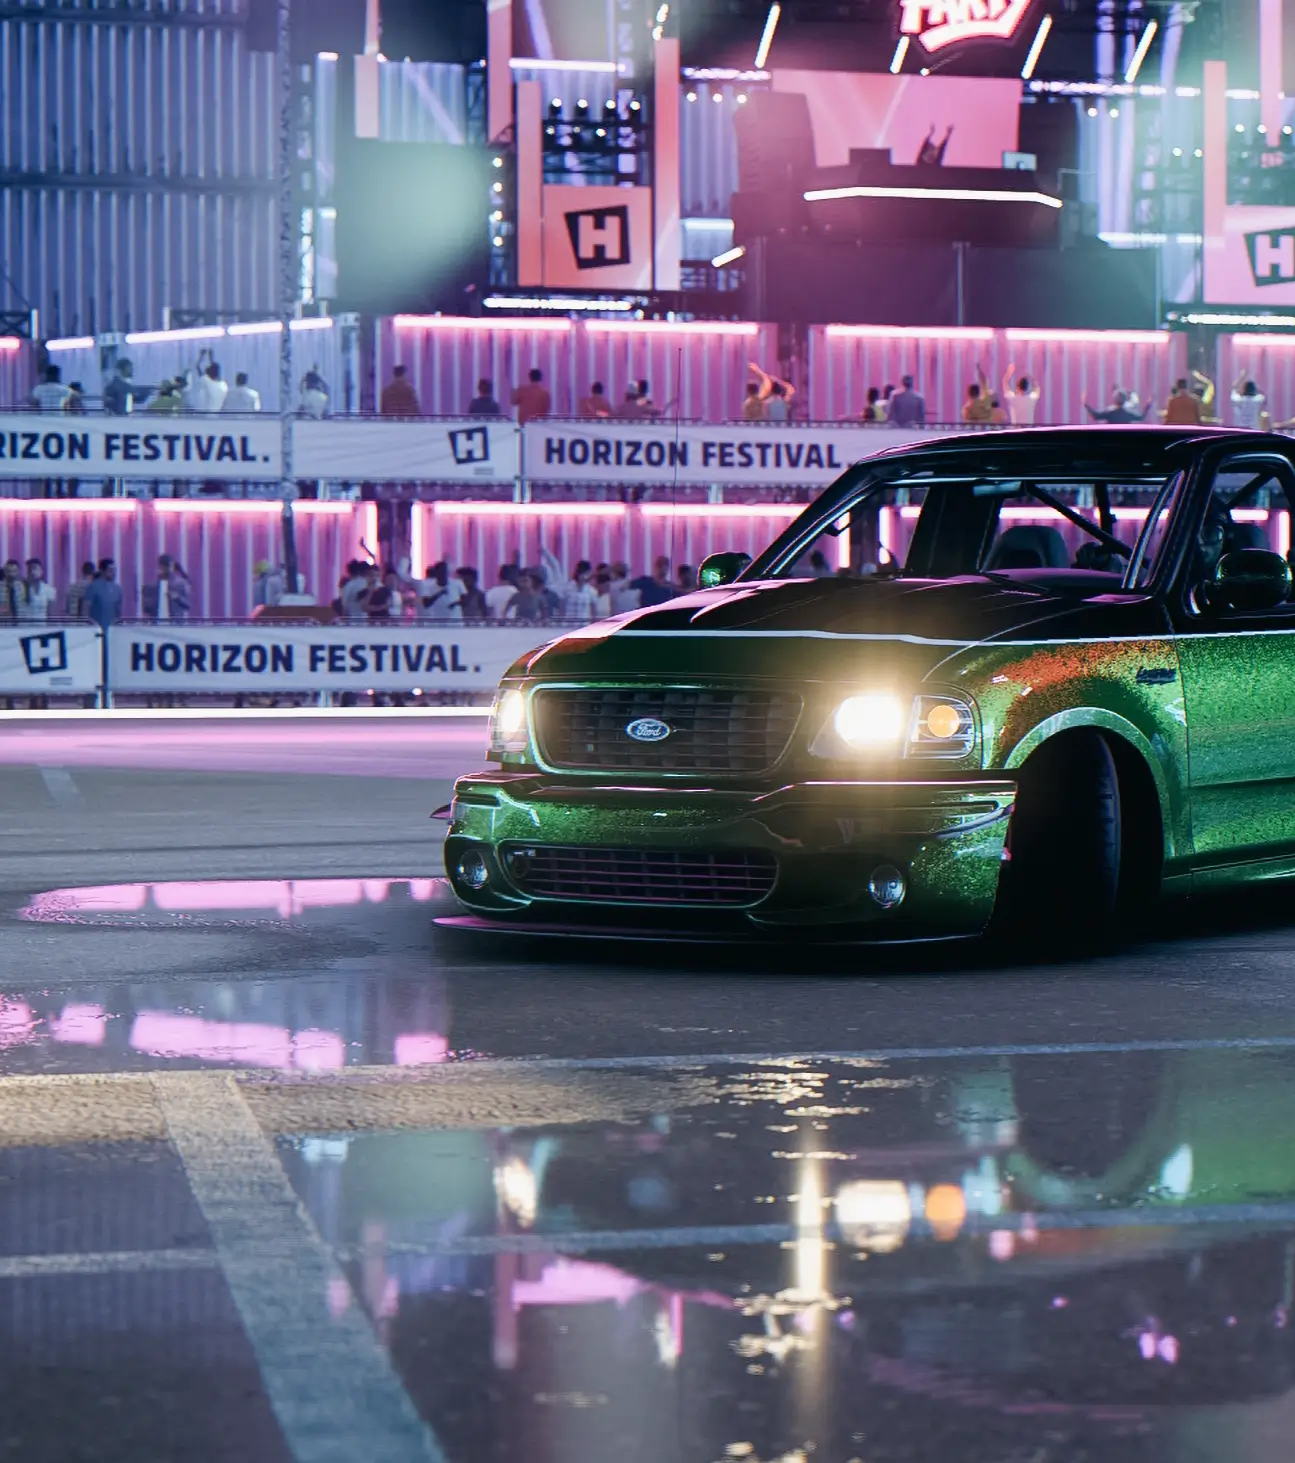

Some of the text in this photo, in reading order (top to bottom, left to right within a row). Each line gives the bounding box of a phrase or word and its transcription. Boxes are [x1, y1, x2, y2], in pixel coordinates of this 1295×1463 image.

[576, 212, 624, 262] H
[104, 433, 270, 463] FESTIVAL.
[453, 430, 486, 460] H
[545, 437, 688, 467] HORIZON
[28, 636, 62, 669] H
[131, 642, 482, 673] HORIZON FESTIVAL.
